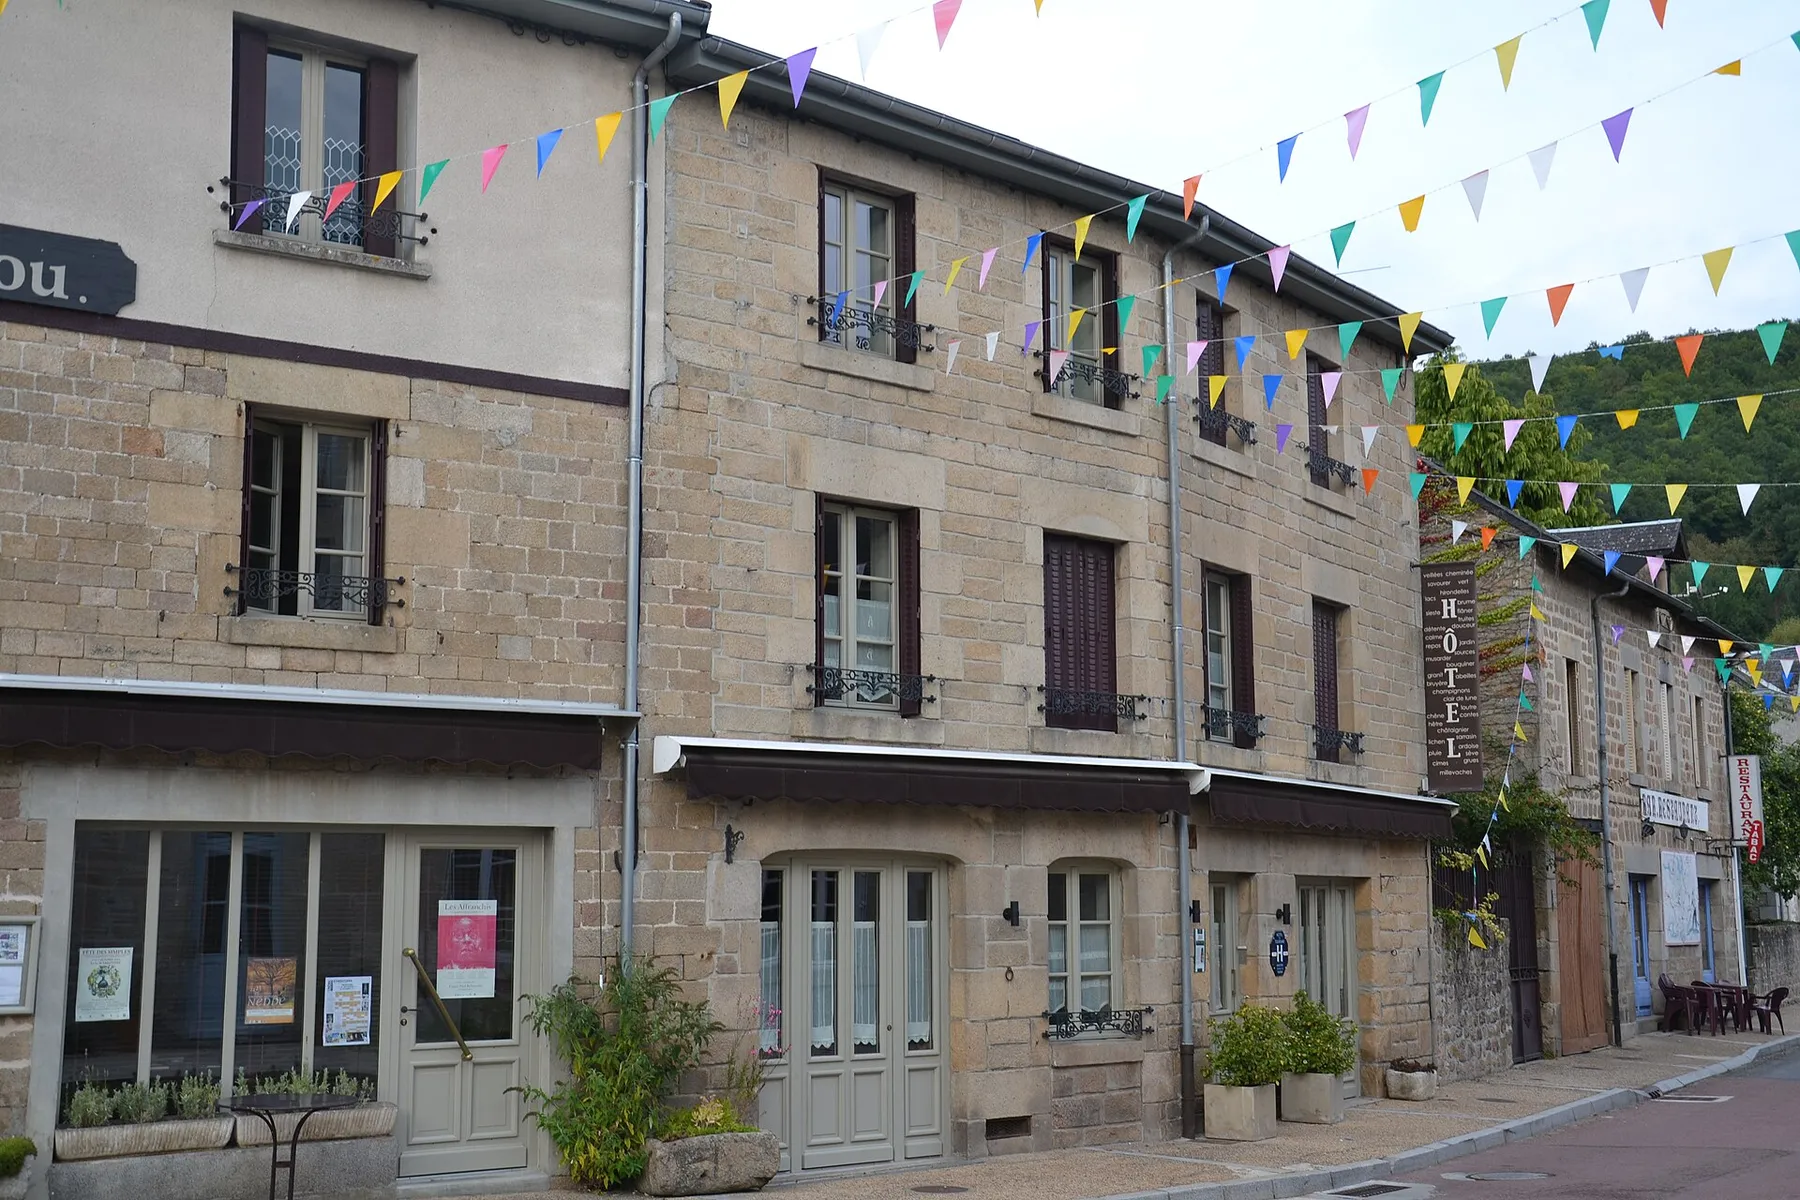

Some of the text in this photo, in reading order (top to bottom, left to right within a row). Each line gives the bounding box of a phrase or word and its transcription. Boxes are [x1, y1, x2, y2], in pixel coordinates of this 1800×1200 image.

[1445, 569, 1474, 577] cheminée
[1441, 597, 1461, 758] HÔTEL
[1737, 758, 1753, 840] RESTAURAN
[1749, 823, 1760, 861] TABAC
[444, 903, 456, 911] Les
[1276, 944, 1284, 963] H
